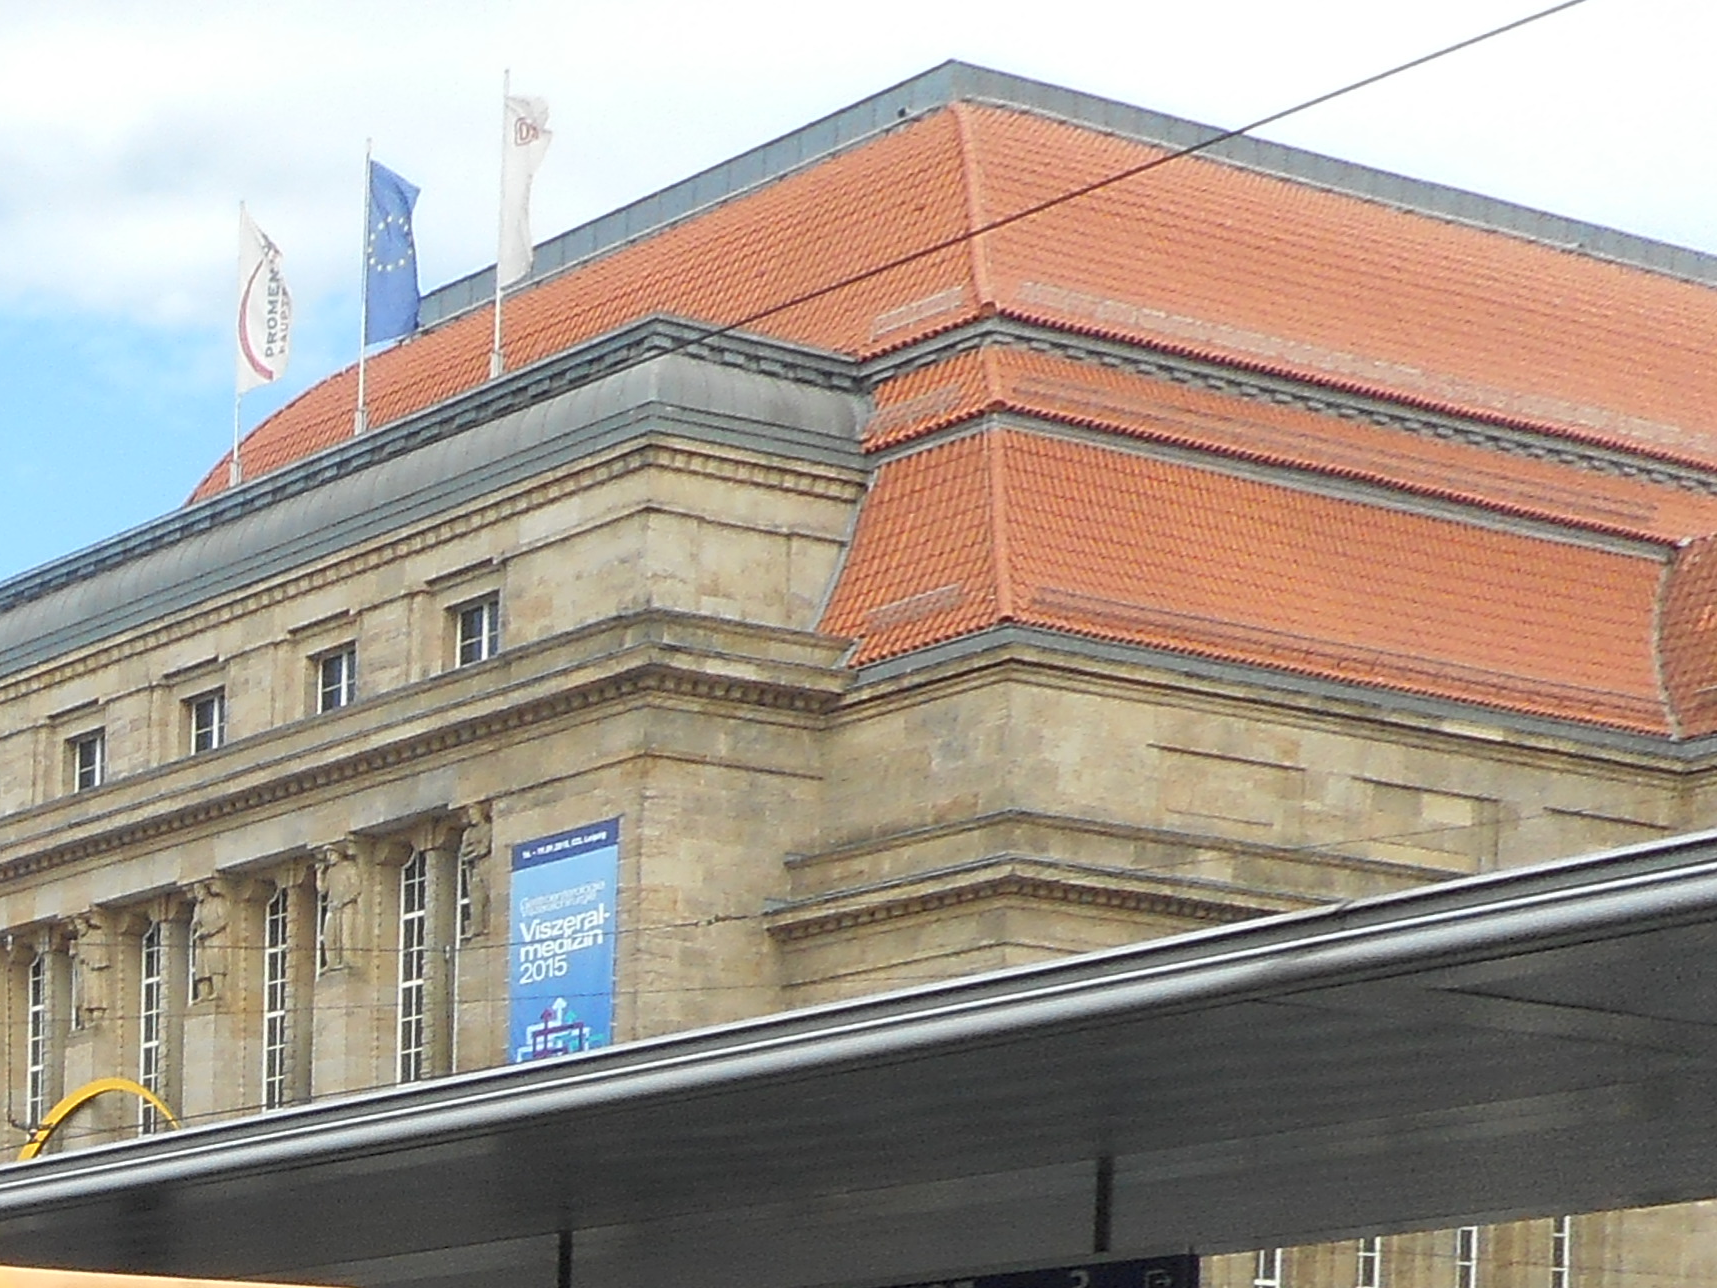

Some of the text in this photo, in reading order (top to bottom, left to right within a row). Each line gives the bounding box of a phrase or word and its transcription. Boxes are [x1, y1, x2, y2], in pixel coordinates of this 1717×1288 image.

[519, 903, 610, 942] Viszeral-
[519, 929, 604, 963] medizin
[519, 955, 568, 984] 2015
